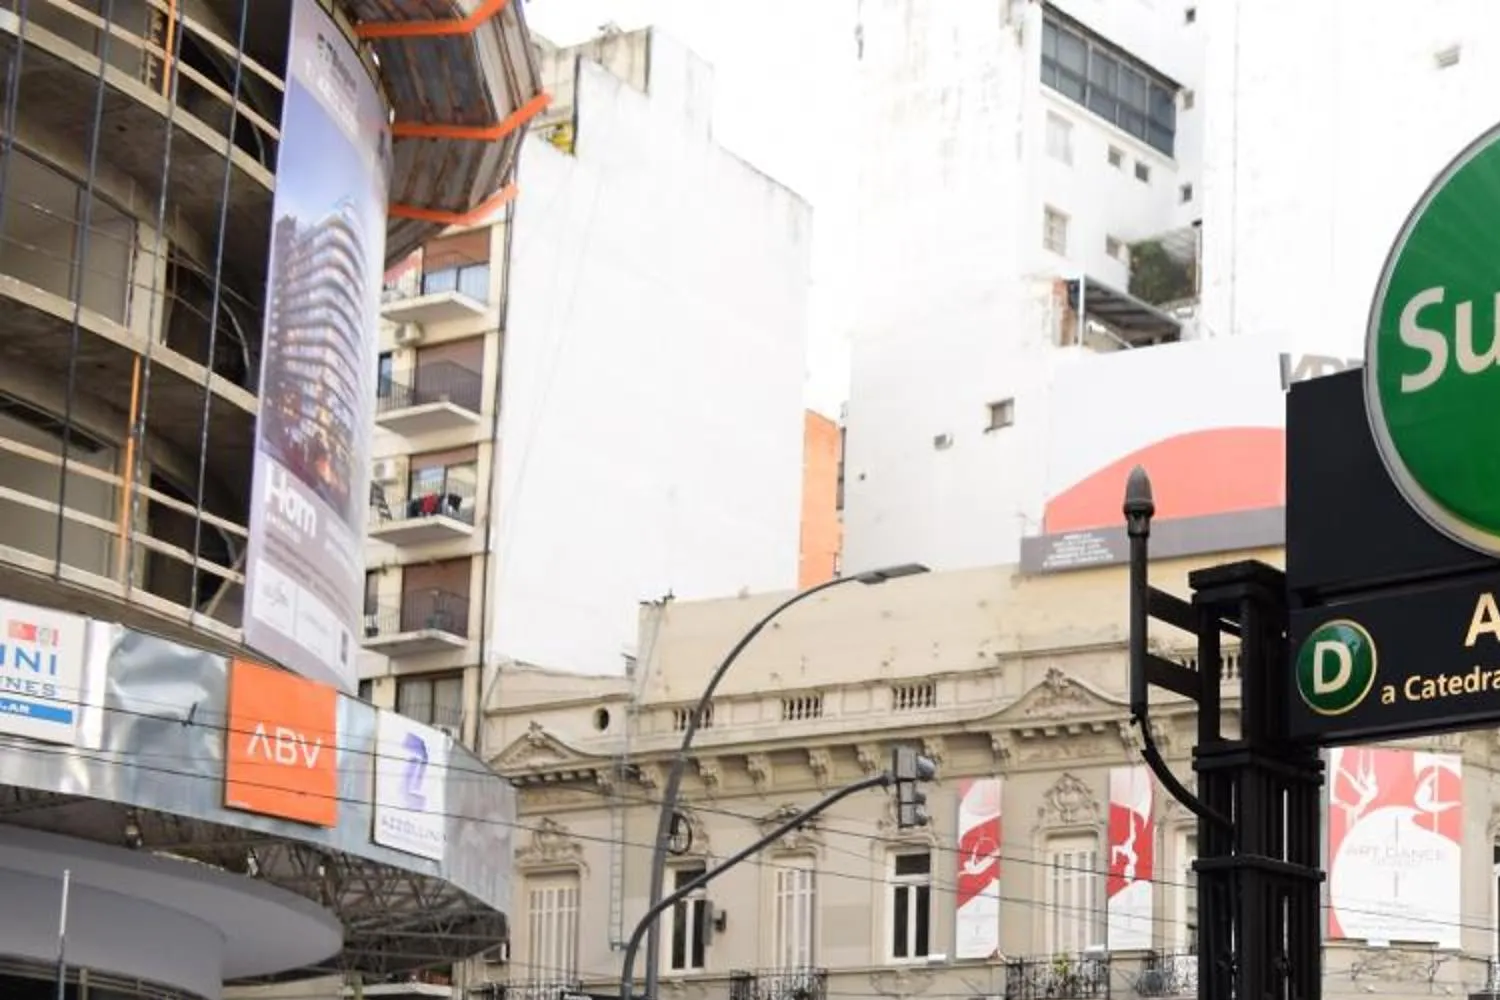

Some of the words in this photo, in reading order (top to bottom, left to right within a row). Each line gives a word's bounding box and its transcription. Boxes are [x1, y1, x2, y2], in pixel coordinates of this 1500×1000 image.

[1313, 640, 1352, 694] D
[0, 675, 56, 697] NES
[1381, 685, 1396, 704] a
